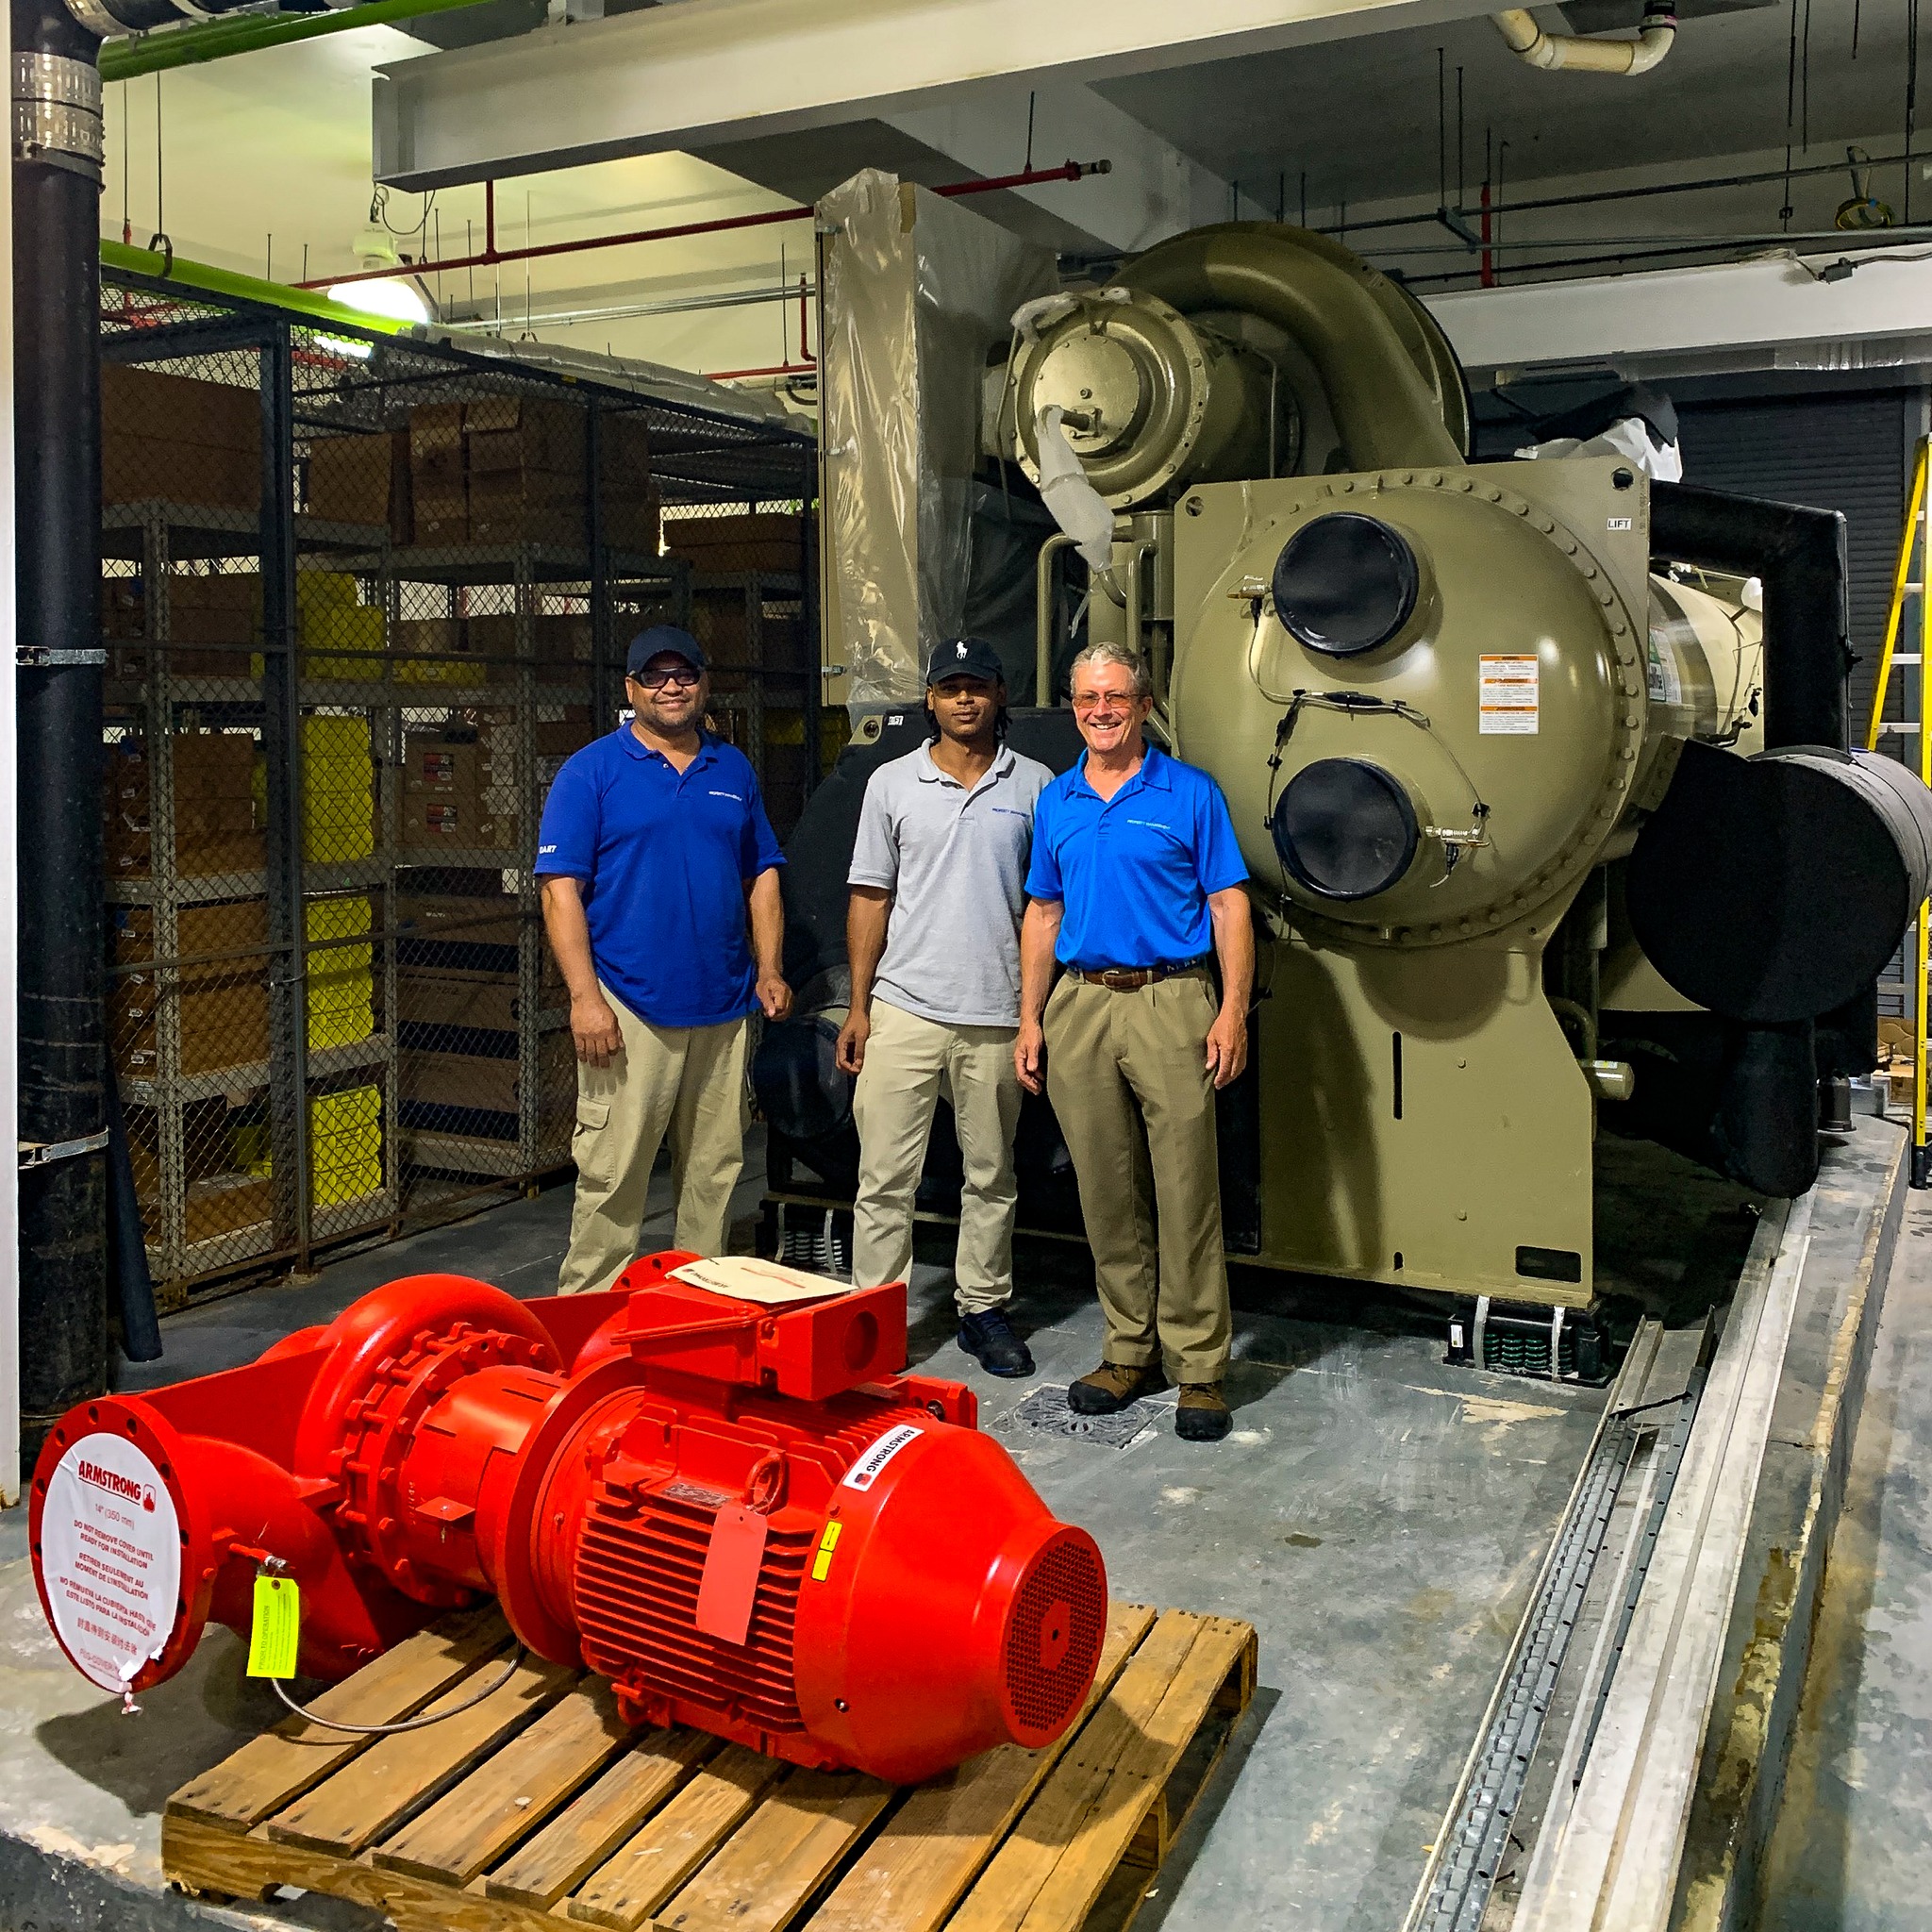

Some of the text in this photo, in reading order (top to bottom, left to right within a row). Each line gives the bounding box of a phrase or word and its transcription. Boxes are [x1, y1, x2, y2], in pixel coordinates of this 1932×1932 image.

[1608, 520, 1629, 528] LIFT
[866, 1428, 916, 1473] ARMSTRONG
[78, 1459, 142, 1501] ARMSTRONG
[74, 1519, 154, 1561] DO NOT REMOVE COVER UNTIL
[80, 1532, 148, 1570] READY FOR INSTALLATION
[75, 1560, 98, 1578] MOMENT
[98, 1572, 107, 1582] DE
[78, 1552, 144, 1589] RETIRER SEULEMENT AU
[59, 1575, 69, 1586] NO
[69, 1580, 94, 1598] REMUEVA
[94, 1592, 102, 1602] LA
[102, 1596, 128, 1616] CUBIERTA
[66, 1590, 79, 1602] ESTE
[79, 1596, 95, 1610] LISTO
[95, 1603, 110, 1617] PARA
[110, 1610, 118, 1621] LA
[261, 1606, 270, 1641] OPERATION
